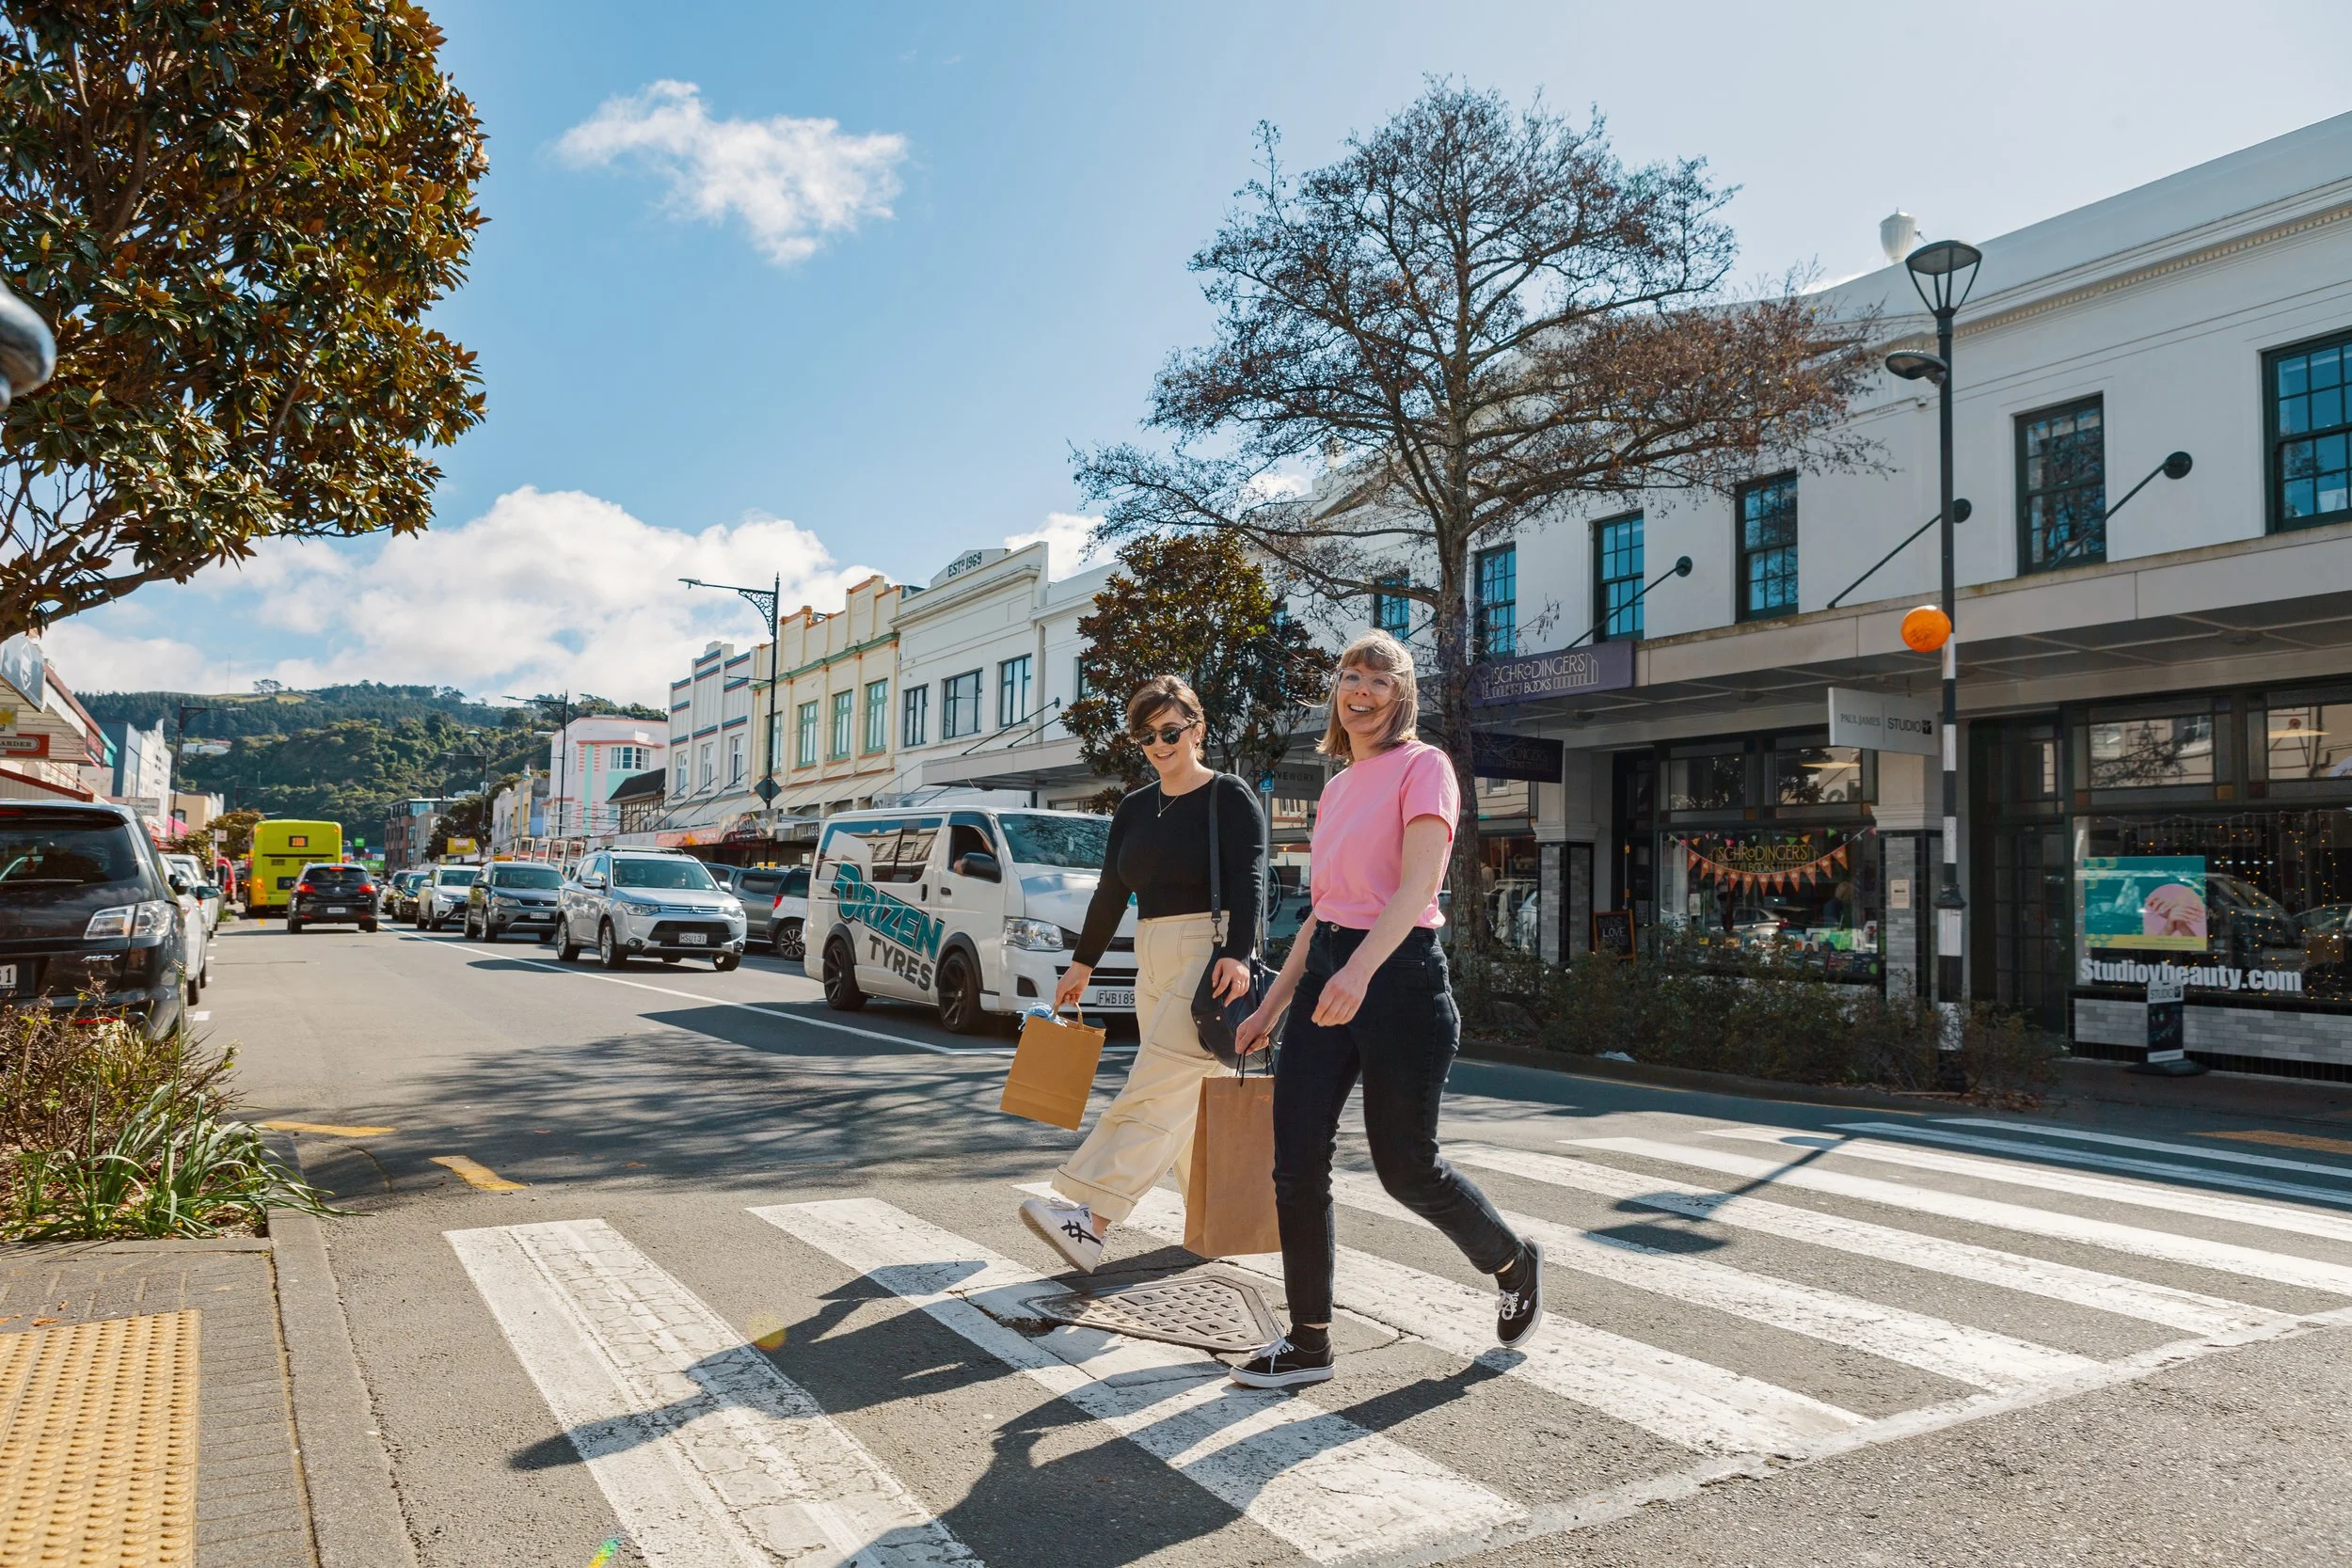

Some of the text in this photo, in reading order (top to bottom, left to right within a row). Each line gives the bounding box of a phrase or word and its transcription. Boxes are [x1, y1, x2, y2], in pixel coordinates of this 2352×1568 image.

[965, 551, 982, 570] 1969
[1524, 678, 1551, 694] BOOKS
[1840, 713, 1881, 726] PAUL JAMES
[1887, 718, 1921, 733] STUDIO
[796, 825, 818, 837] VILLAGE
[1748, 862, 1776, 873] BOOKS
[679, 933, 707, 942] HSU131
[1602, 927, 1627, 938] LOVE
[868, 934, 933, 991] TYRES
[1098, 991, 1136, 1005] FWB189
[2150, 989, 2174, 1001] STUDIO
